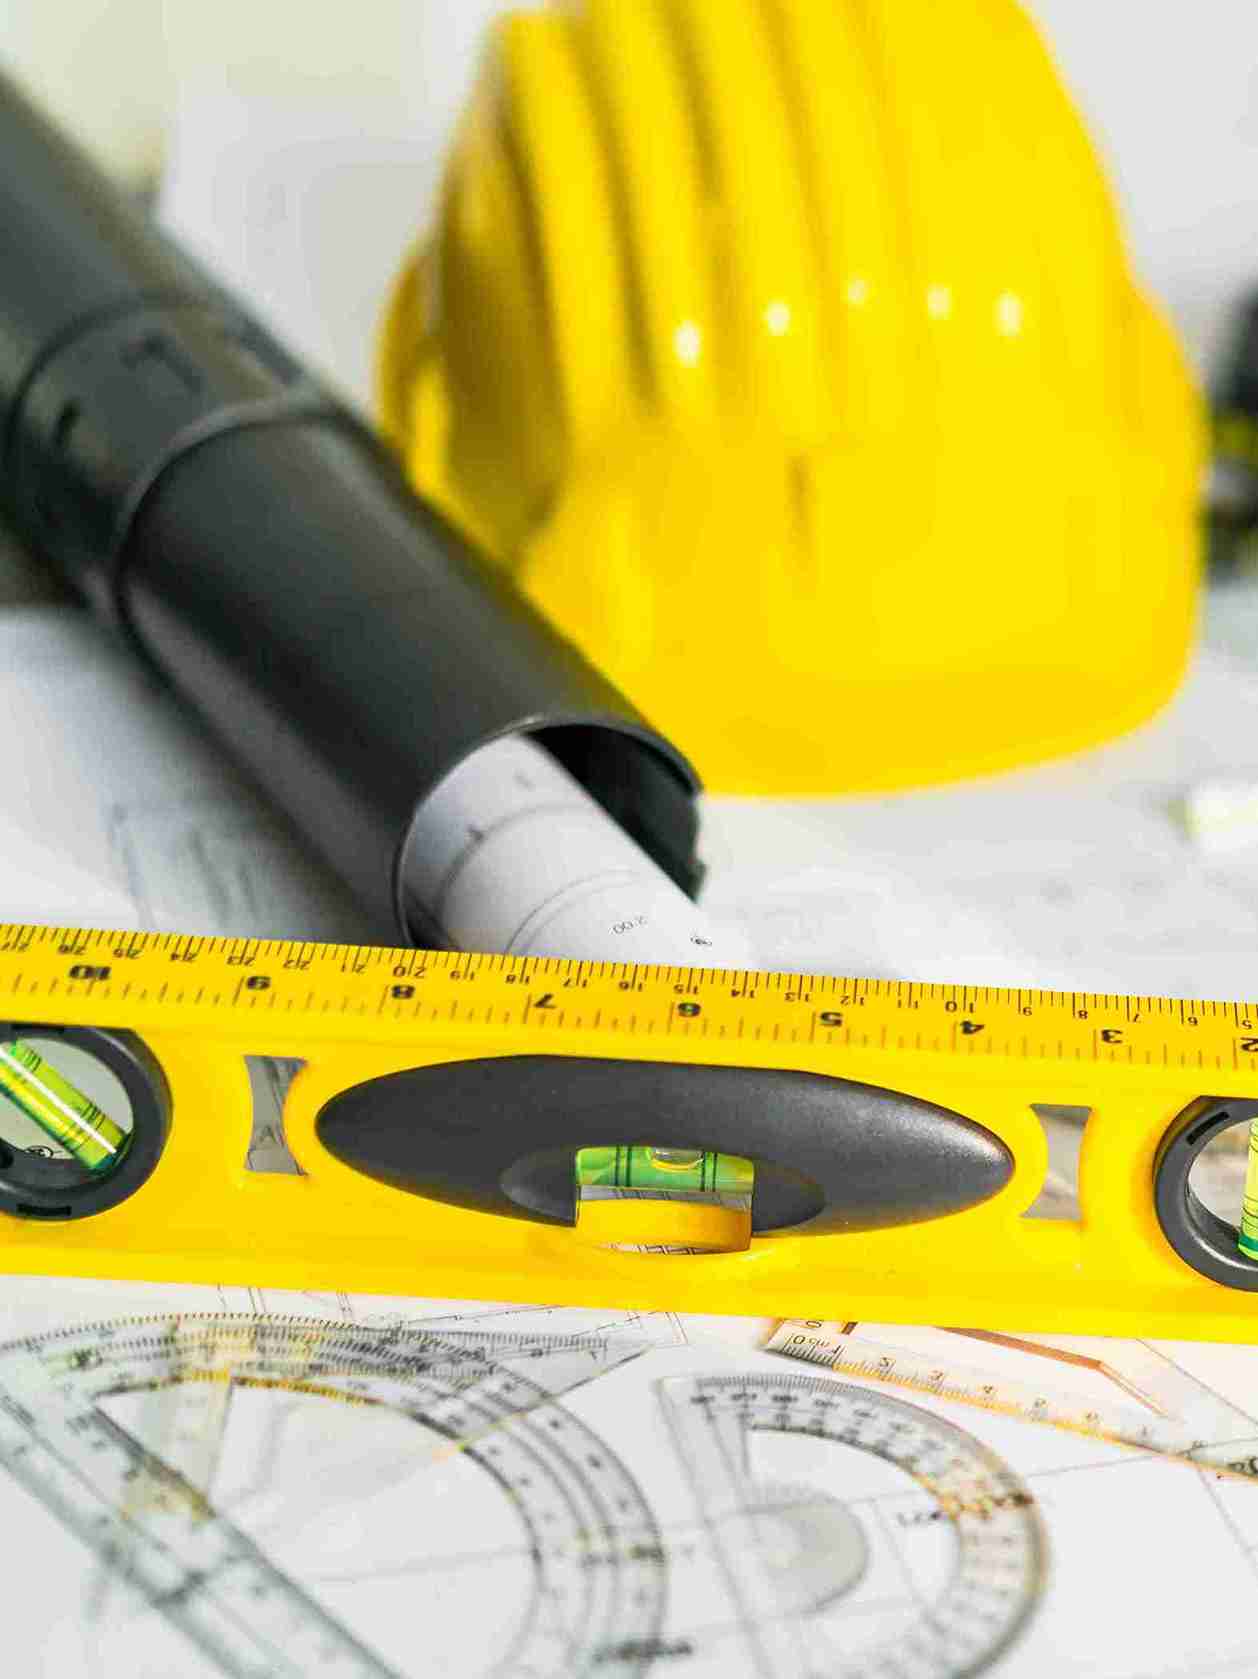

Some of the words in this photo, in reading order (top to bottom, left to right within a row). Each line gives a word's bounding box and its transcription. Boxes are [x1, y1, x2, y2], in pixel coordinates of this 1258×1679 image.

[226, 955, 255, 966] 23
[283, 959, 311, 970] 22
[69, 964, 112, 981] 10
[340, 963, 366, 974] 21
[392, 966, 426, 979] 20
[450, 970, 475, 981] 19
[505, 974, 530, 985] 18
[246, 974, 271, 990] 9
[563, 978, 587, 988] 17
[618, 980, 643, 992] 16
[391, 984, 416, 999] 8
[673, 984, 698, 995] 15
[731, 988, 755, 999] 14
[533, 992, 558, 1009] 7
[784, 991, 810, 1002] 13
[840, 995, 865, 1006] 12
[677, 1001, 702, 1018] 6
[897, 999, 919, 1010] 11
[945, 1001, 974, 1013] 10
[1022, 1006, 1033, 1017] 9
[1078, 1009, 1089, 1020] 8
[819, 1011, 844, 1028] 5
[1133, 1013, 1144, 1023] 7
[1187, 1016, 1198, 1026] 6
[959, 1019, 985, 1035] 4
[1242, 1019, 1253, 1030] 5
[1101, 1028, 1124, 1044] 3
